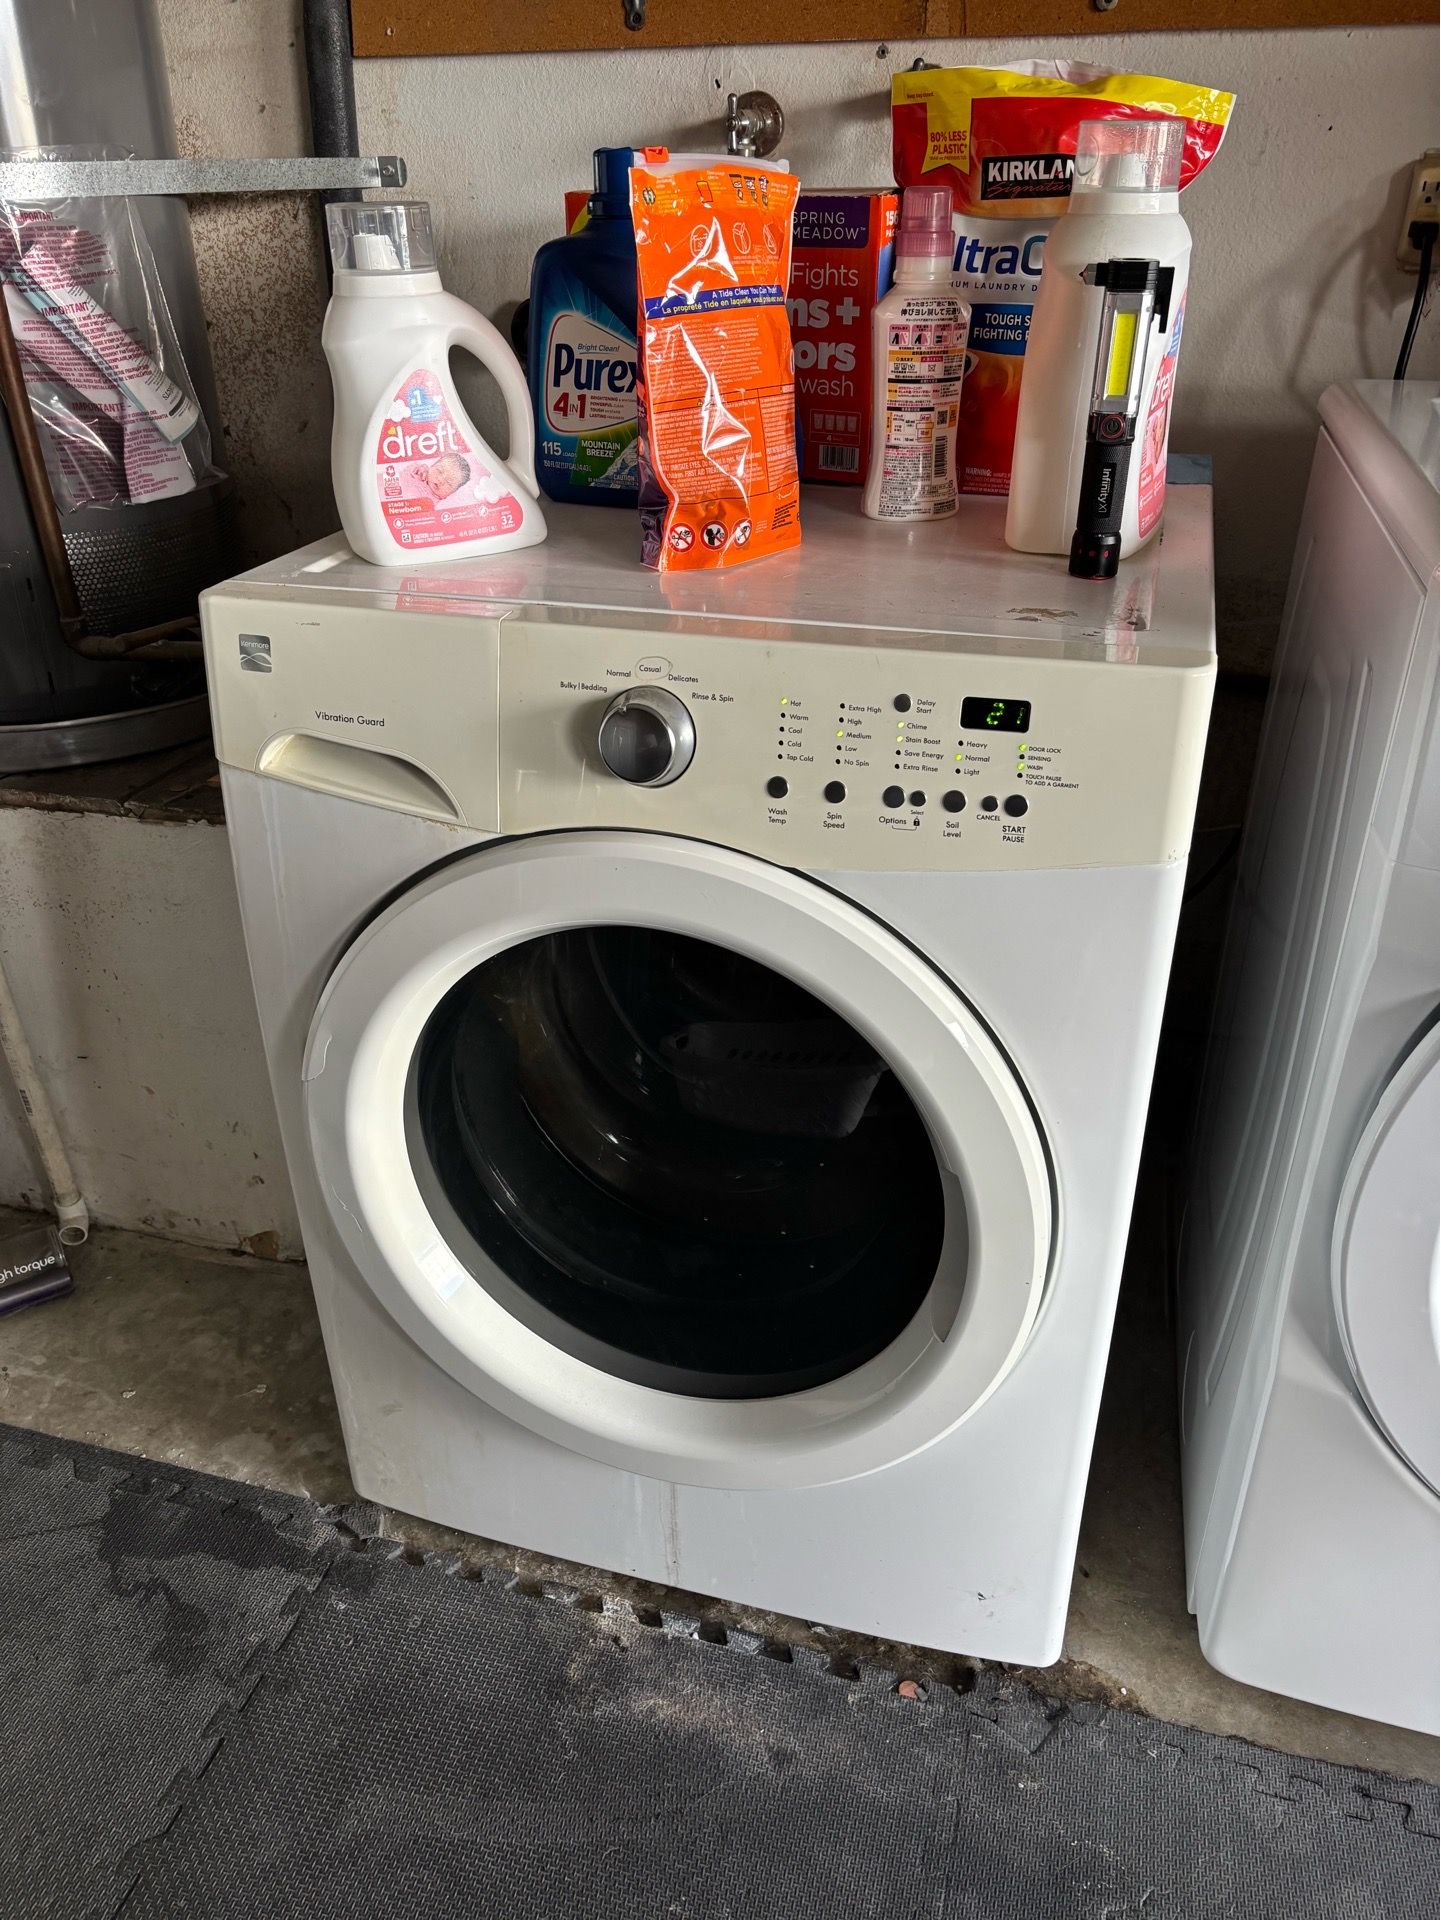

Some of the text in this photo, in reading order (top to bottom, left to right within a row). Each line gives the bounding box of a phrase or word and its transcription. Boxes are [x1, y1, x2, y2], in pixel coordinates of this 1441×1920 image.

[930, 130, 967, 142] 80% LESS
[988, 158, 1075, 182] KIRKLAN
[988, 181, 1073, 199] Signatur
[792, 212, 845, 224] SPRING
[952, 235, 1048, 276] ltraC
[791, 262, 859, 290] Fights
[974, 282, 1026, 291] LAUNDRY
[720, 289, 732, 297] Tide
[735, 287, 749, 295] Clean
[41, 302, 89, 316] IMPORTANT
[703, 300, 718, 309] Tide
[786, 297, 860, 328] ns +
[985, 313, 1031, 326] TOUGH S
[973, 328, 1022, 341] FIGHTING
[578, 343, 597, 351] Bright
[793, 340, 856, 372] ors
[553, 343, 637, 393] Purex
[799, 375, 853, 397] wash
[553, 392, 586, 418] 4 IN 1
[382, 421, 458, 459] dreft
[581, 440, 620, 450] MOUNTAIN
[542, 441, 561, 456] 115
[1098, 468, 1112, 503] Infinity
[388, 506, 422, 514] Newborn
[501, 515, 513, 525] 32
[240, 639, 269, 649] Kenmore
[606, 669, 631, 678] Normal
[639, 664, 661, 673] Casual
[668, 673, 699, 683] Delicates
[691, 692, 710, 701] Rinse
[719, 694, 734, 703] Spin
[917, 699, 936, 707] Delay
[315, 711, 385, 727] Vibration Guard
[789, 713, 809, 721] Warm
[846, 732, 872, 740] Medium
[905, 736, 922, 744] Stain
[966, 741, 988, 749] Heavy
[922, 751, 944, 760] Energy
[965, 755, 990, 763] Normal
[963, 768, 980, 776] Light
[768, 817, 787, 825] Temp
[826, 812, 842, 820] Spin
[878, 816, 907, 826] Options
[976, 814, 1001, 822] CANCEL
[823, 821, 845, 829] Speed
[945, 821, 959, 829] Soil
[1002, 826, 1026, 834] START
[943, 830, 962, 839] Level
[1002, 835, 1025, 843] PAUSE
[0, 1256, 55, 1284] gh torque
